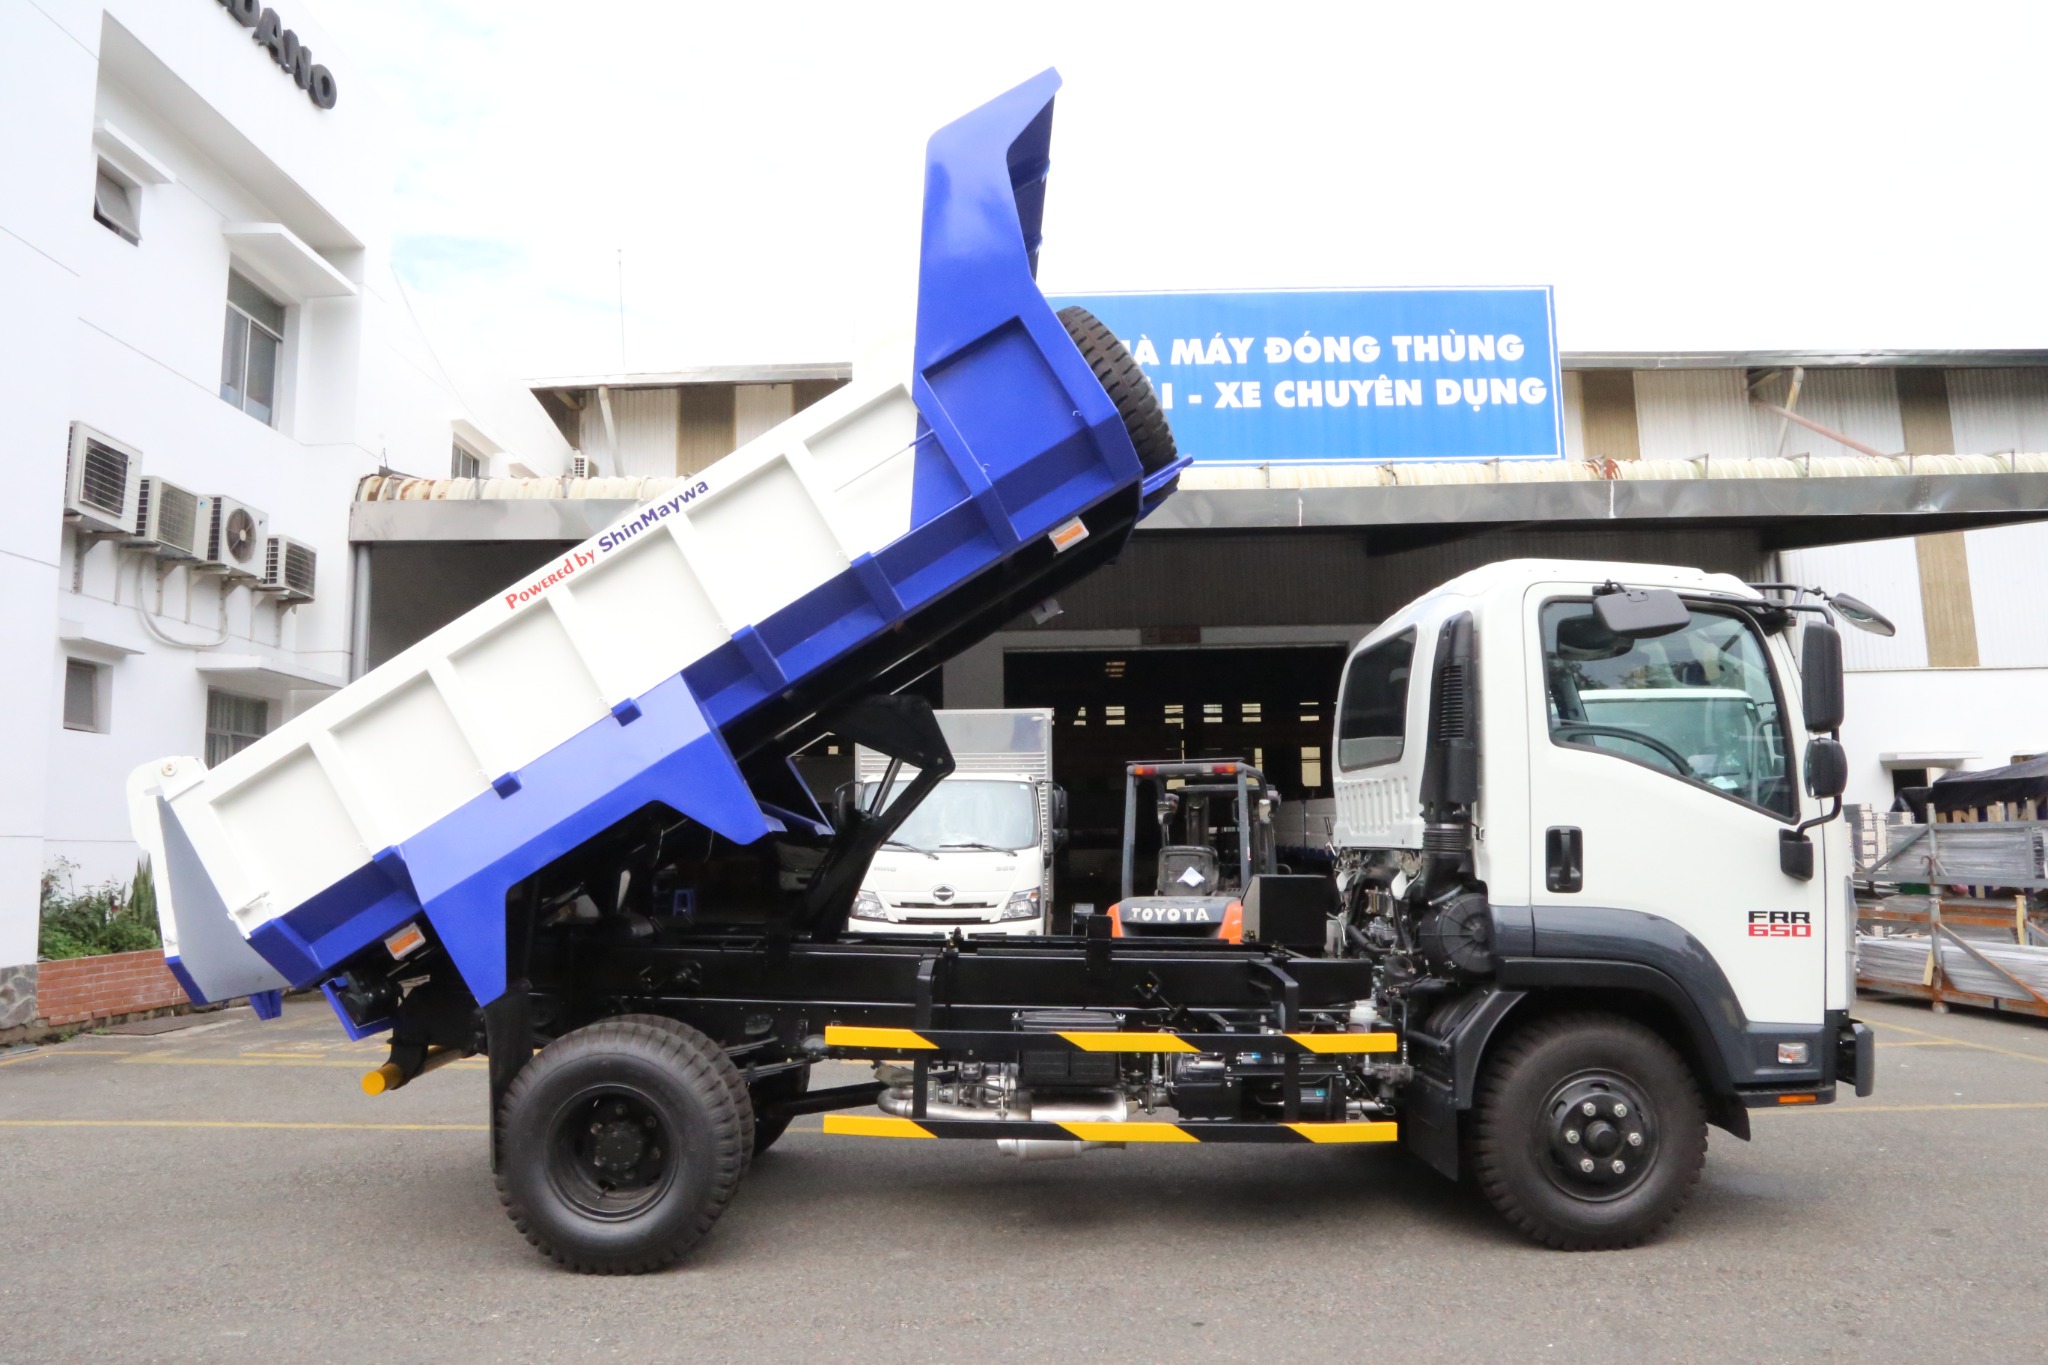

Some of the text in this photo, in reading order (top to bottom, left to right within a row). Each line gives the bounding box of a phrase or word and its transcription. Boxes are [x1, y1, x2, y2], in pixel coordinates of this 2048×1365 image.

[1170, 332, 1255, 365] MÁY
[1264, 331, 1381, 363] ĐÓNG
[1391, 329, 1525, 362] THÙNG
[1214, 381, 1262, 409] XE
[1274, 374, 1422, 408] CHUYÊN
[1436, 377, 1548, 412] DỤNG
[573, 549, 595, 565] by
[598, 480, 709, 553] ShinMaywa
[1131, 907, 1210, 922] TOYOTA
[1748, 911, 1811, 924] FRR
[1748, 924, 1811, 937] 650
